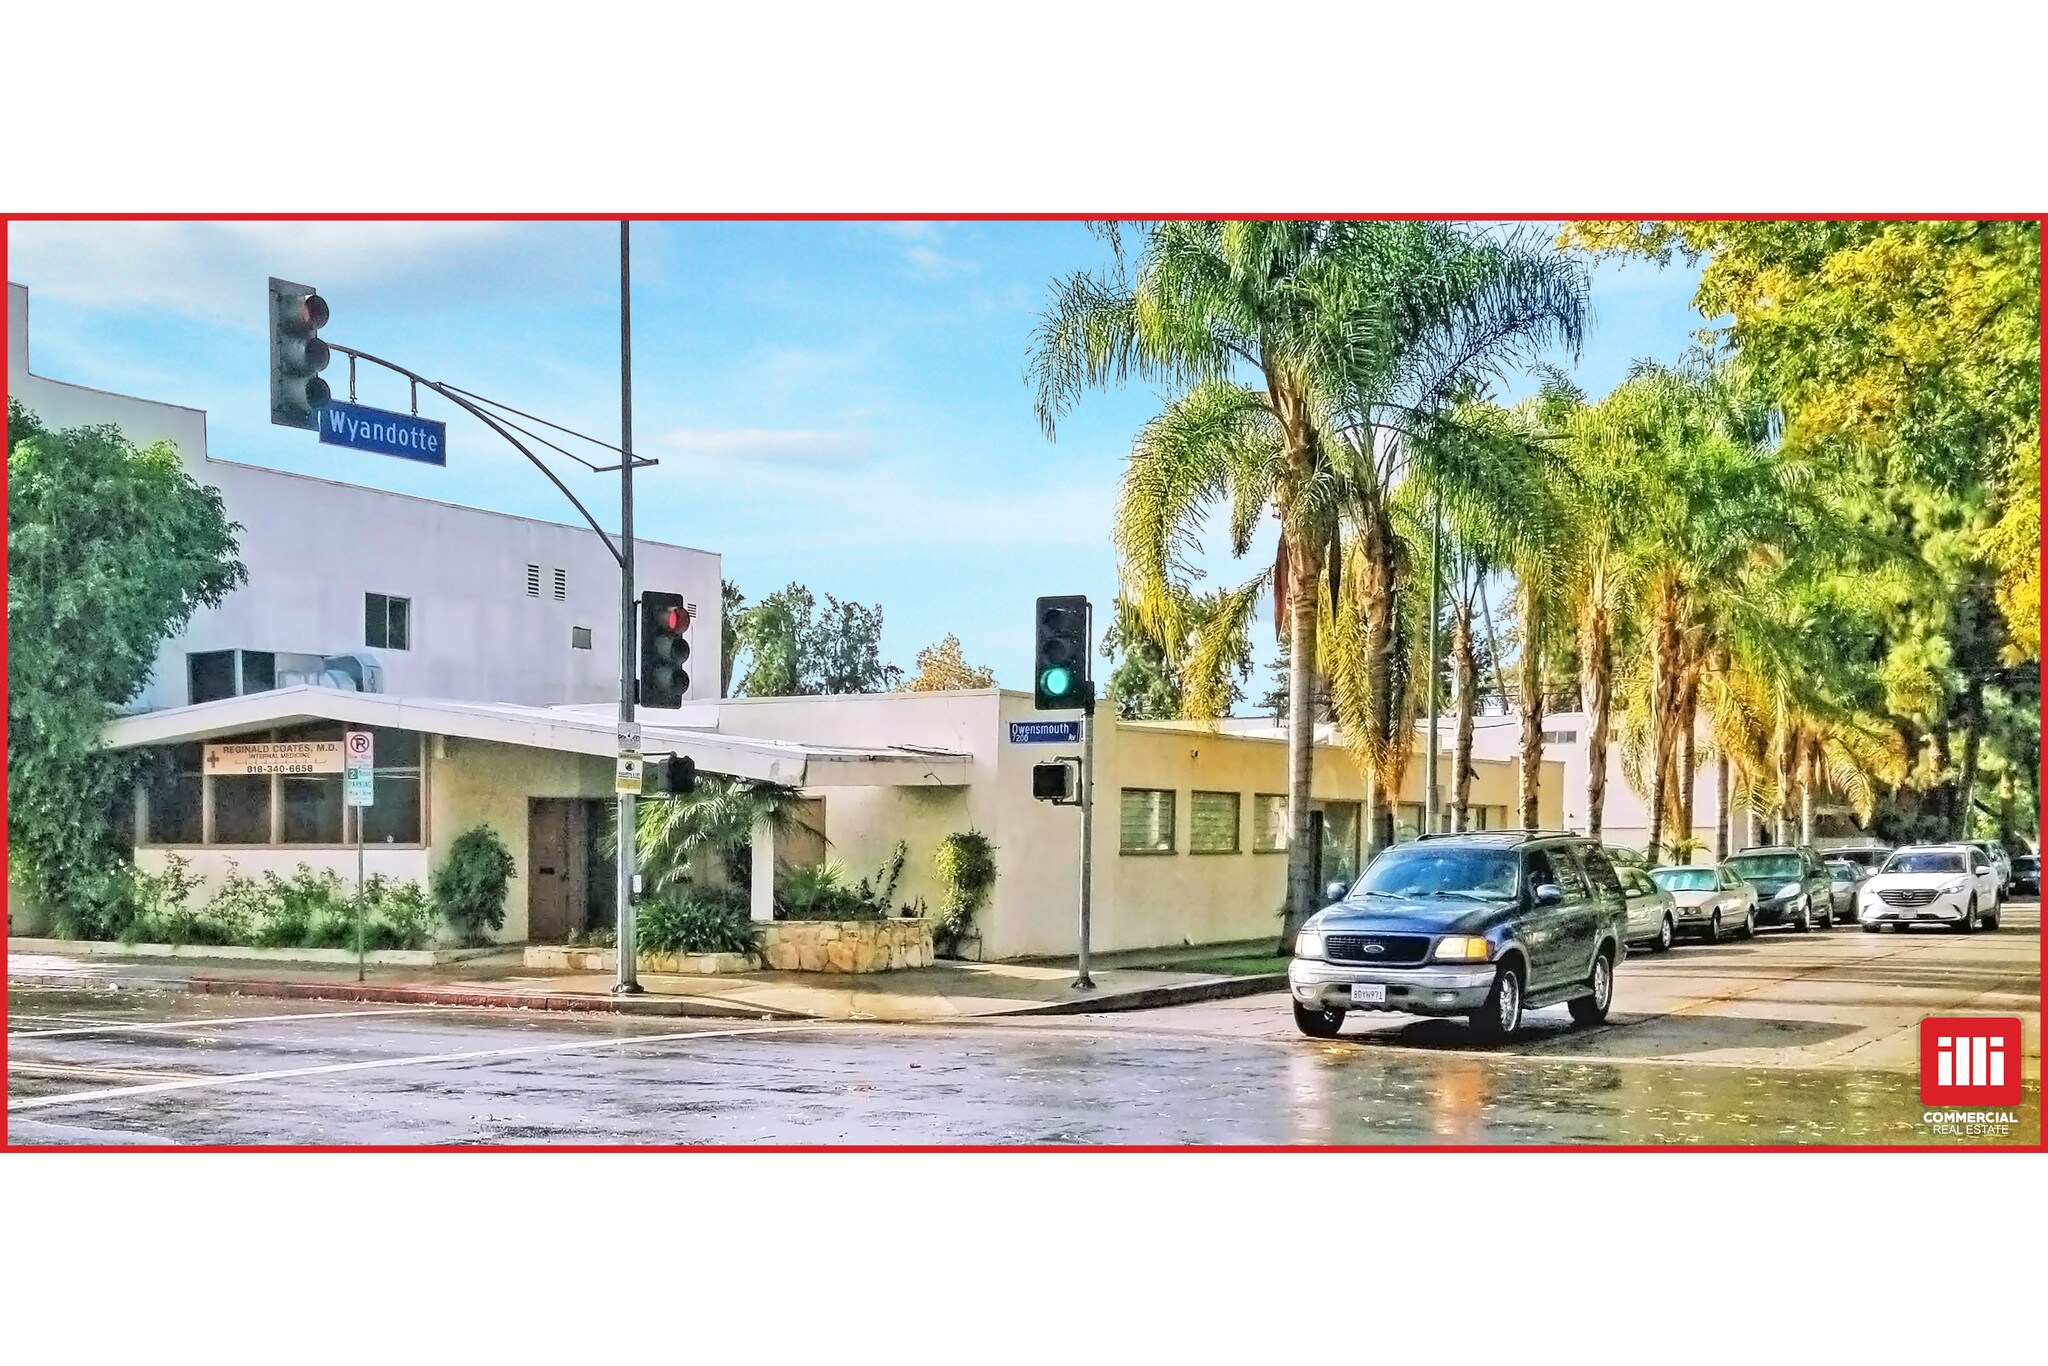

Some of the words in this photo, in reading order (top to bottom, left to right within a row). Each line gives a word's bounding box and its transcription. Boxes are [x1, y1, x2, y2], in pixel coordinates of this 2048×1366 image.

[330, 409, 438, 452] Wyandotte
[1011, 723, 1069, 735] Owensmouth
[1012, 734, 1029, 742] 7200
[223, 745, 270, 754] REGINALD
[272, 744, 313, 754] COATES,
[316, 743, 338, 752] M.D.
